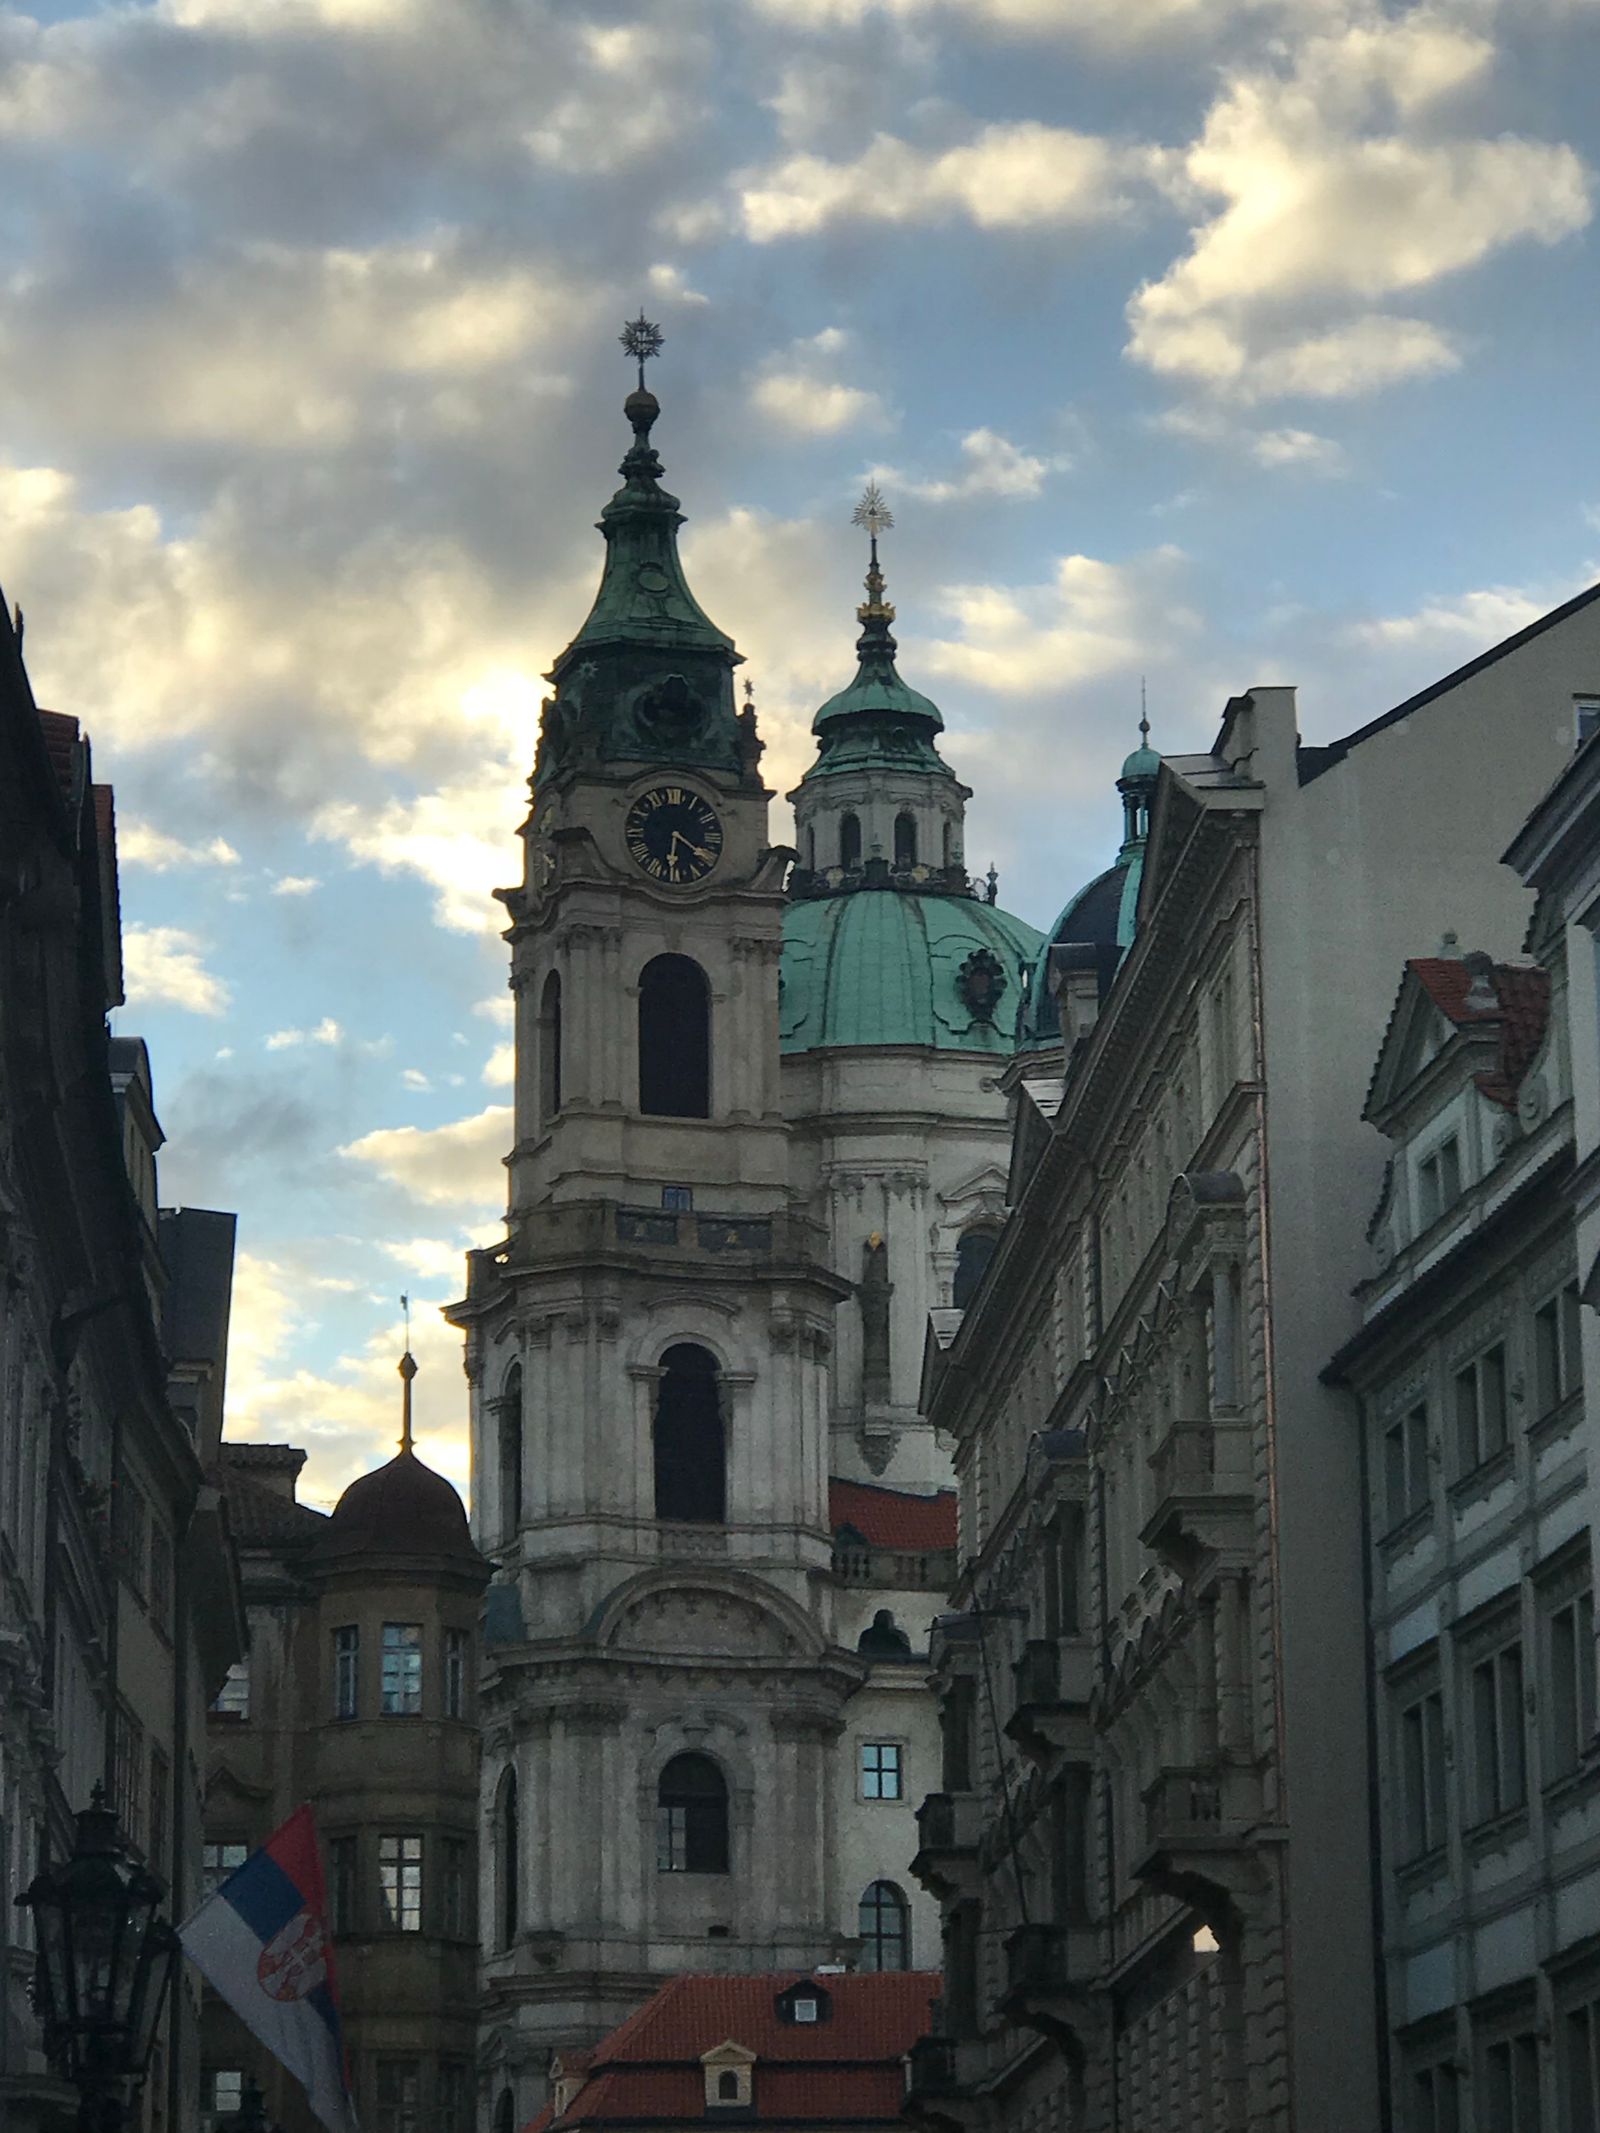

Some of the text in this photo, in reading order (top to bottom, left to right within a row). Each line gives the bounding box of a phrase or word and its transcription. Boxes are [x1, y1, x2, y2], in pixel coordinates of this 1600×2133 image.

[666, 788, 682, 805] XII
[688, 796, 698, 810] I
[700, 812, 716, 824] II
[704, 832, 721, 844] III
